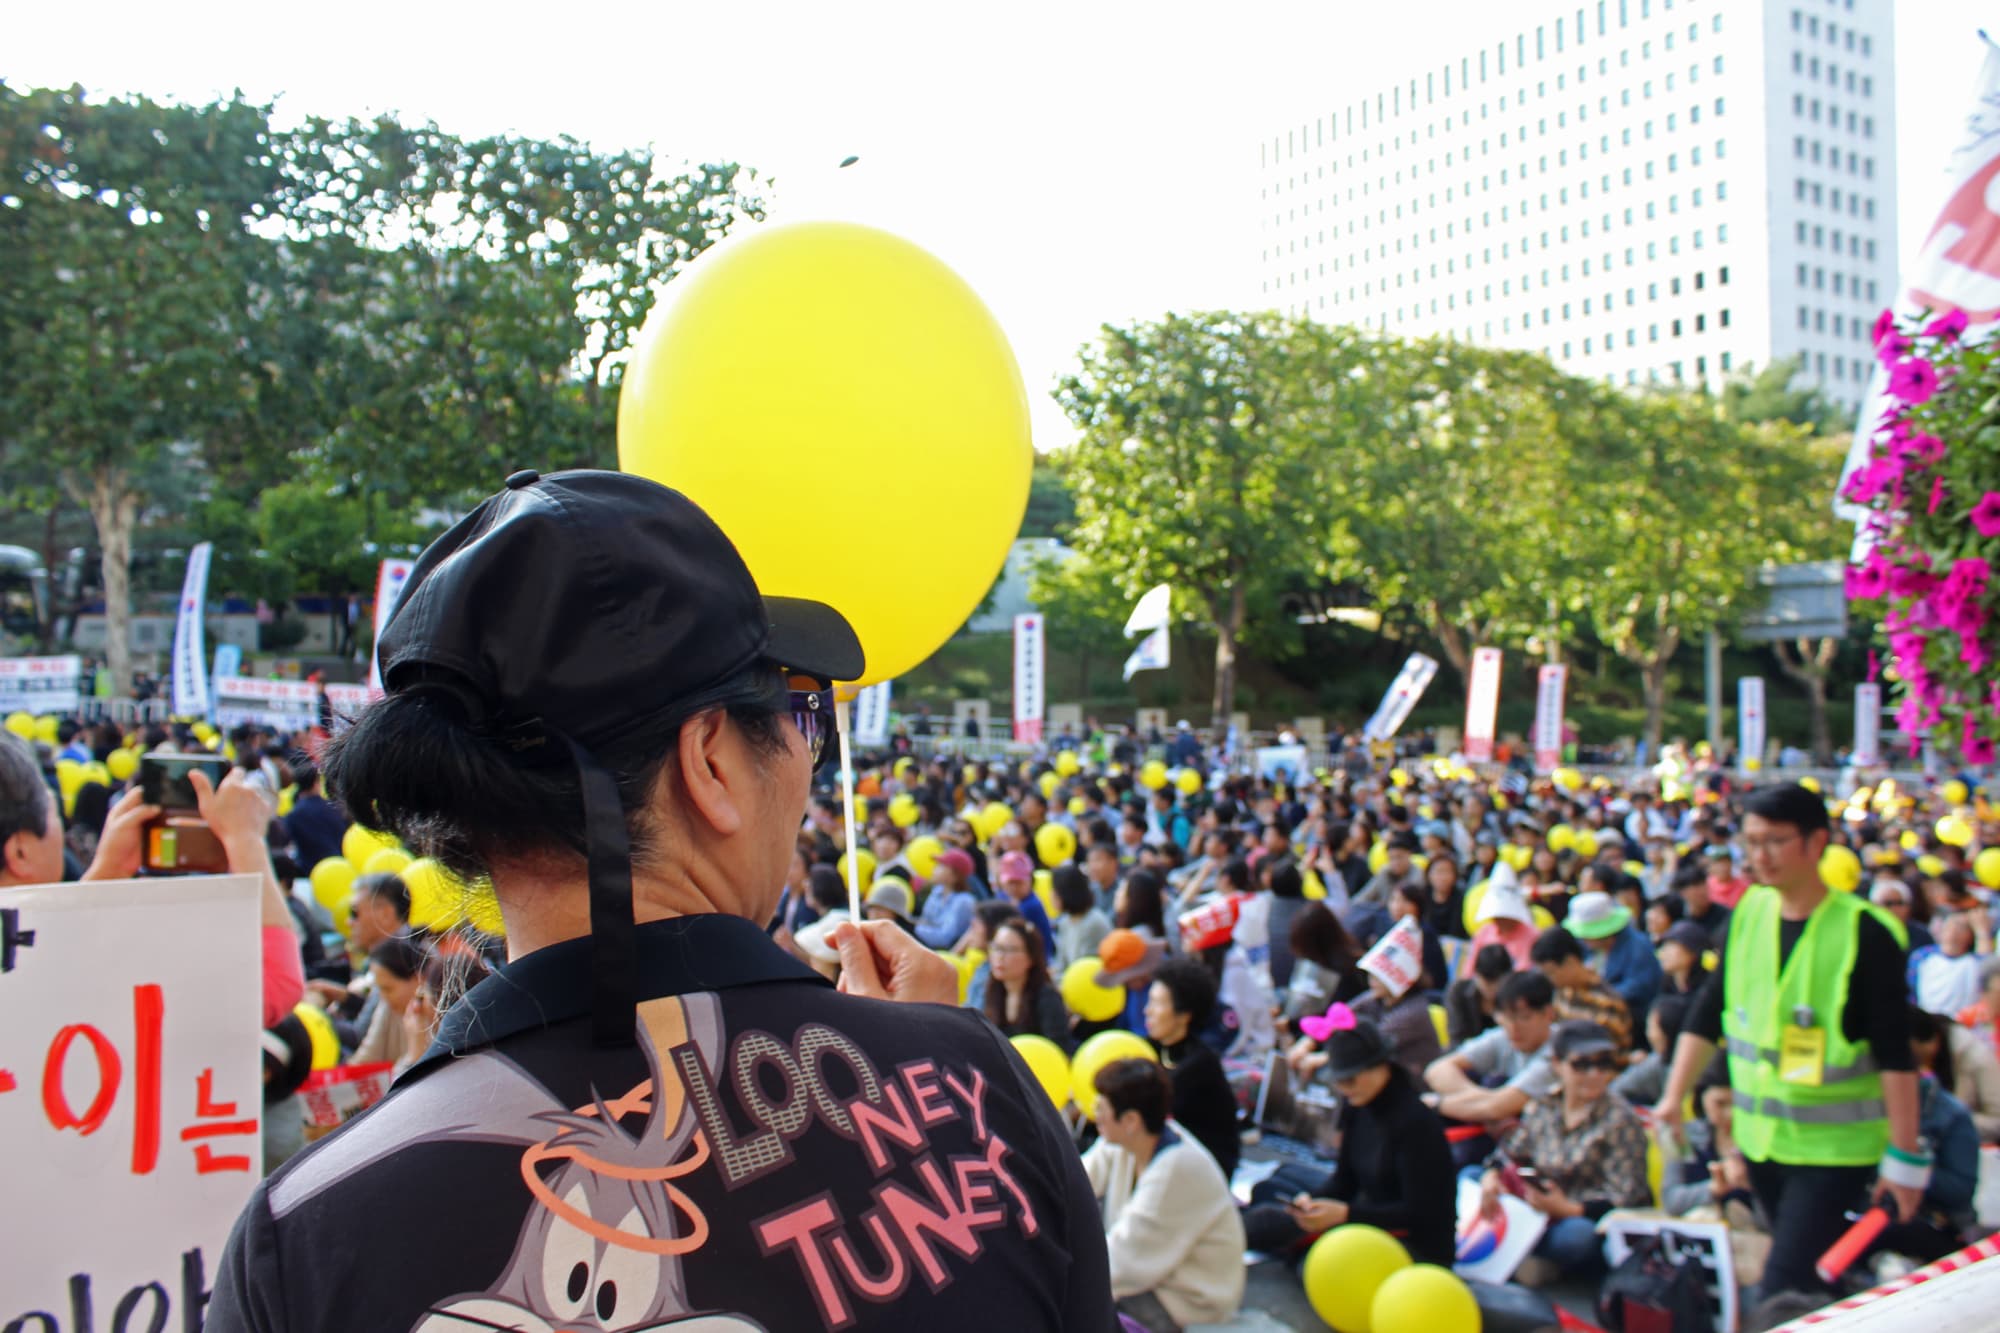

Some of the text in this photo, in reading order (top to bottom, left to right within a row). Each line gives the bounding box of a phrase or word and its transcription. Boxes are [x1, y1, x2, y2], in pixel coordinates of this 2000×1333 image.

[0, 983, 258, 1175] 이는
[672, 1024, 987, 1188] LOONEY
[752, 1136, 1040, 1330] TUNES
